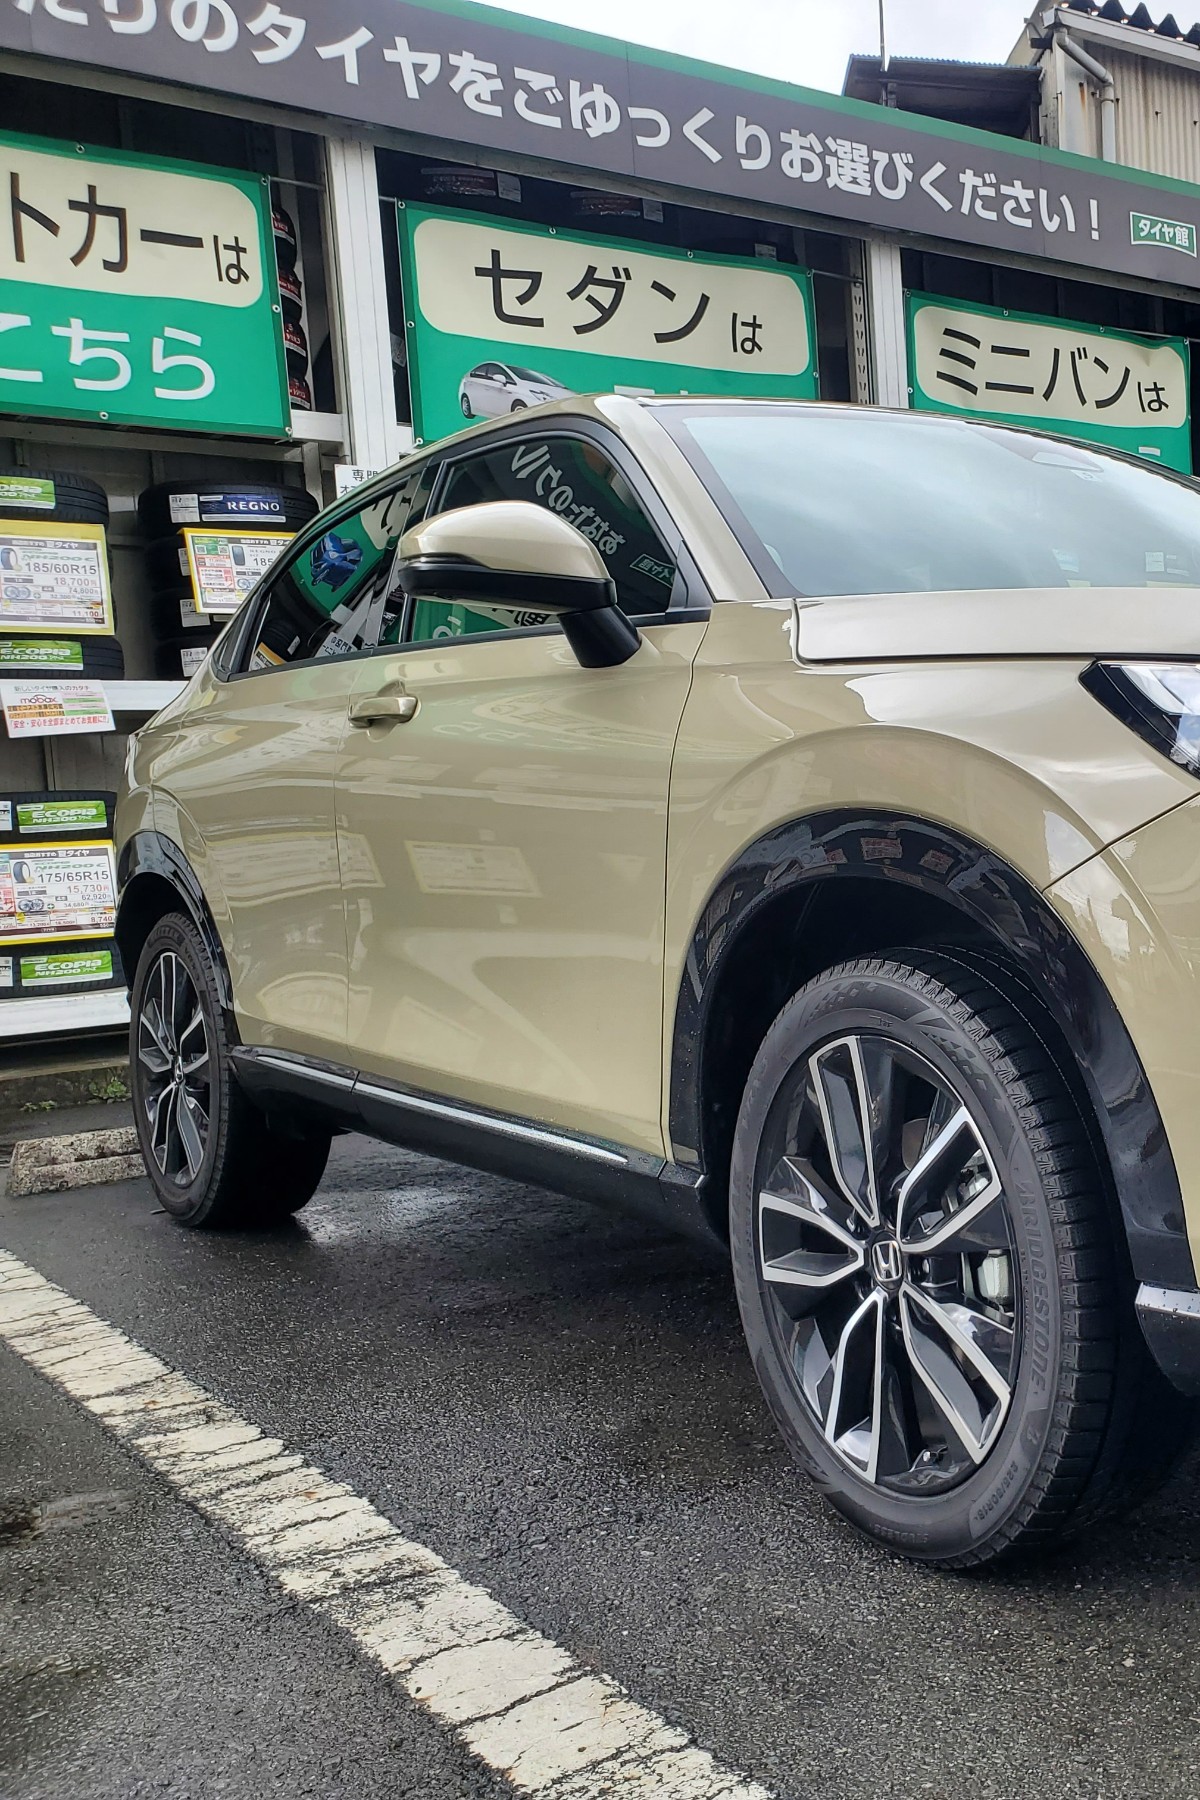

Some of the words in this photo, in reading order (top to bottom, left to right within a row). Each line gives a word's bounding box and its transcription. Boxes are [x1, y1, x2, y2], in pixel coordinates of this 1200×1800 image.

[1138, 219, 1190, 247] タイヤ館
[474, 248, 763, 355] セダンは
[936, 327, 1170, 413] ミニバンは
[227, 501, 280, 511] REGNO
[25, 563, 97, 574] 185/60R15
[38, 870, 109, 884] 175/65R15
[34, 960, 102, 971] ECOPIA
[1013, 1179, 1051, 1393] BRIDGESTONE
